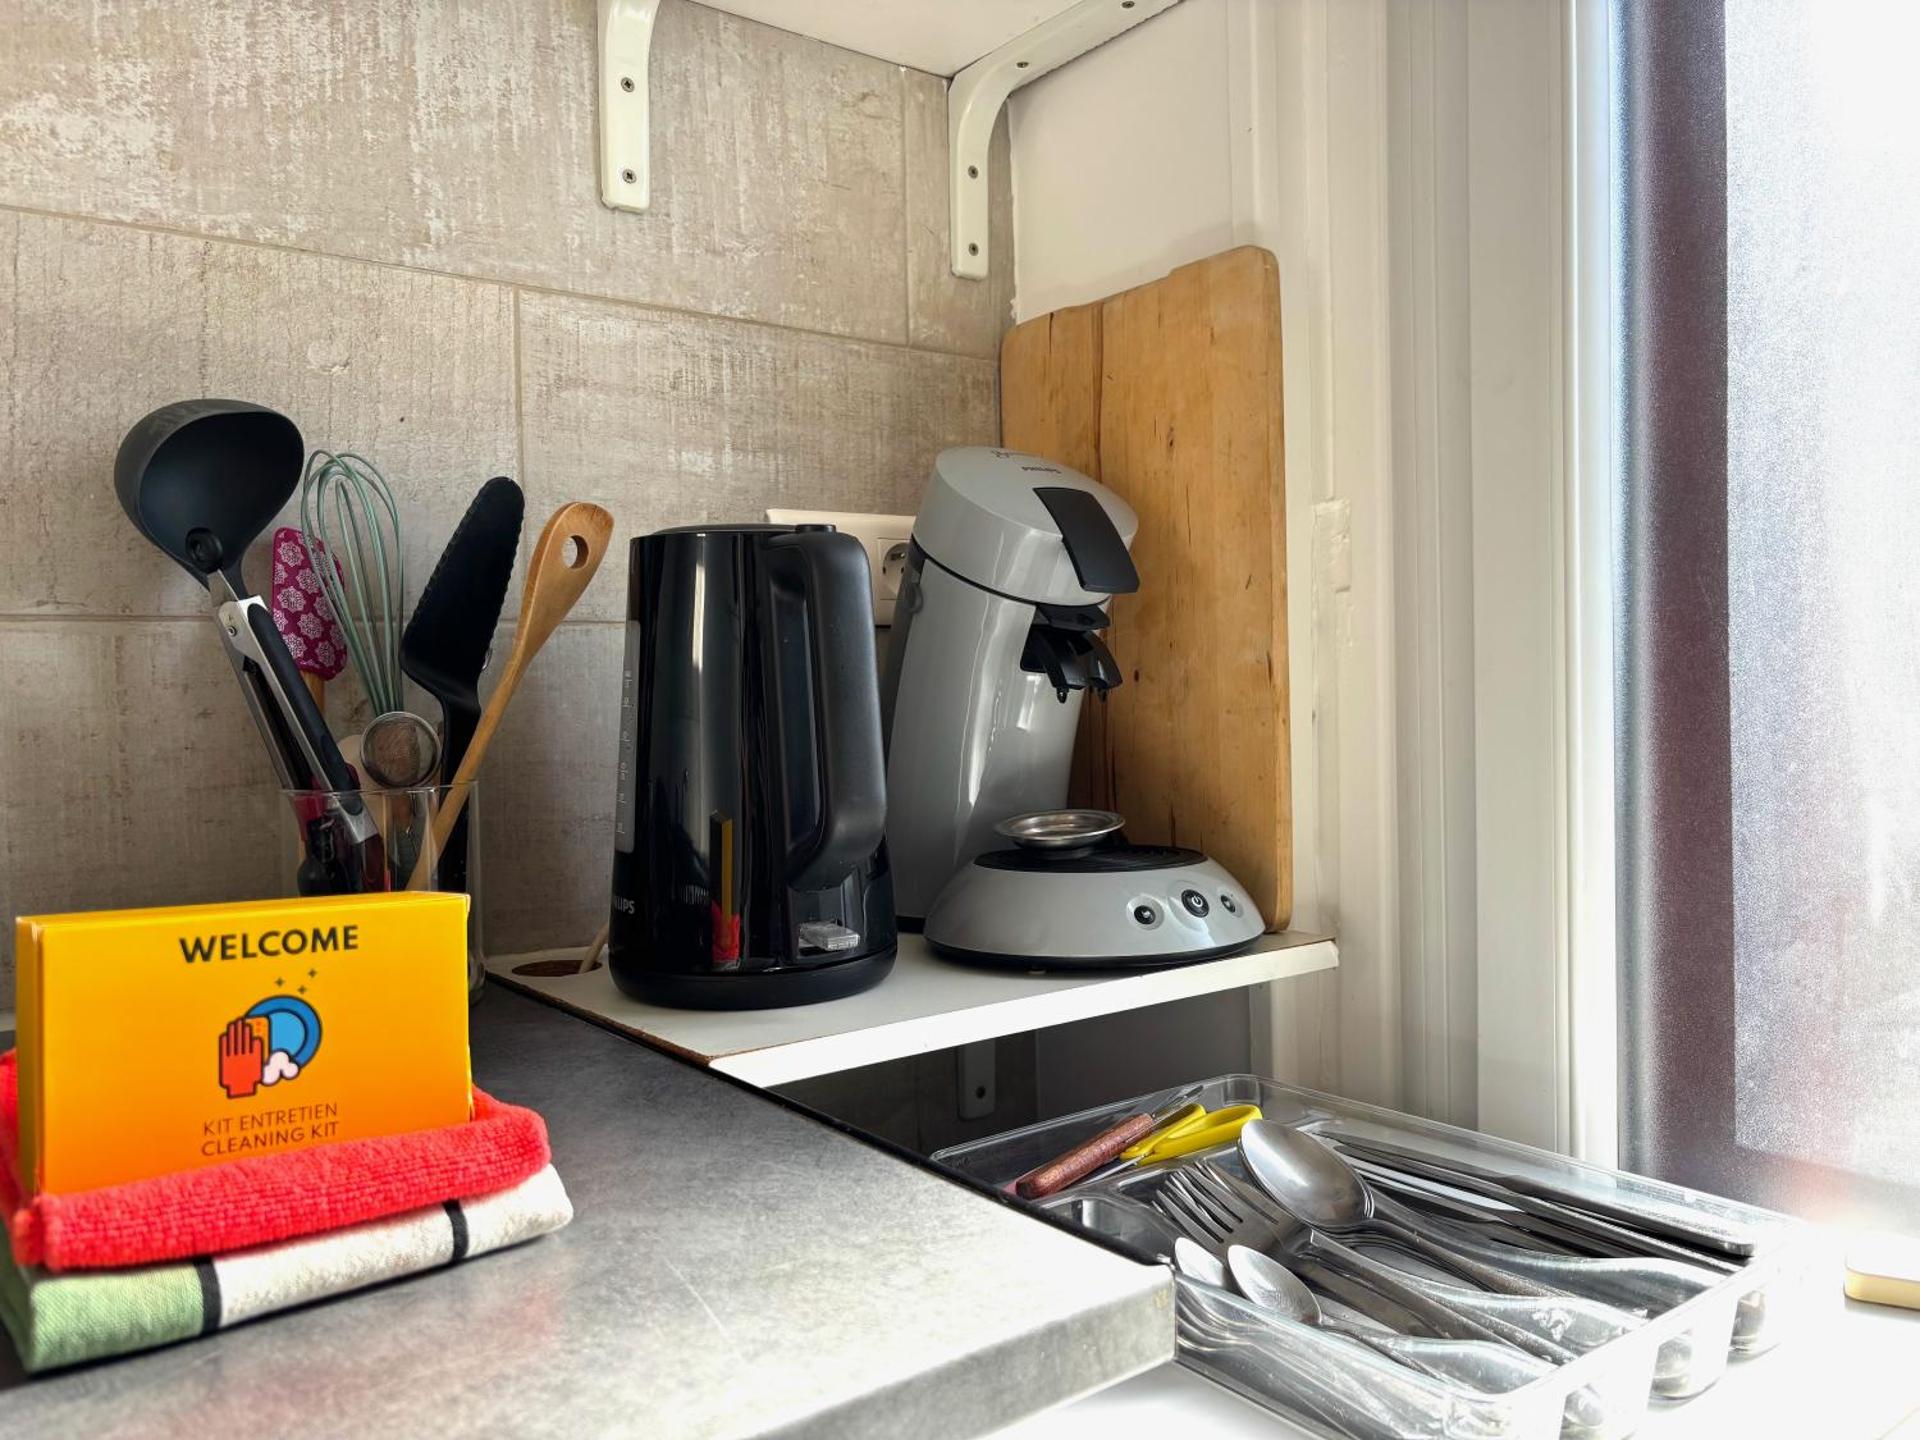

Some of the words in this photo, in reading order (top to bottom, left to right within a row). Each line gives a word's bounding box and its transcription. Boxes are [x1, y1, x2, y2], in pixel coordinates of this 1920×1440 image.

[178, 924, 359, 964] WELCOME
[203, 1118, 233, 1136] KIT
[239, 1102, 338, 1131] ENTRETIEN
[201, 1127, 305, 1156] CLEANING
[311, 1121, 340, 1139] KIT
